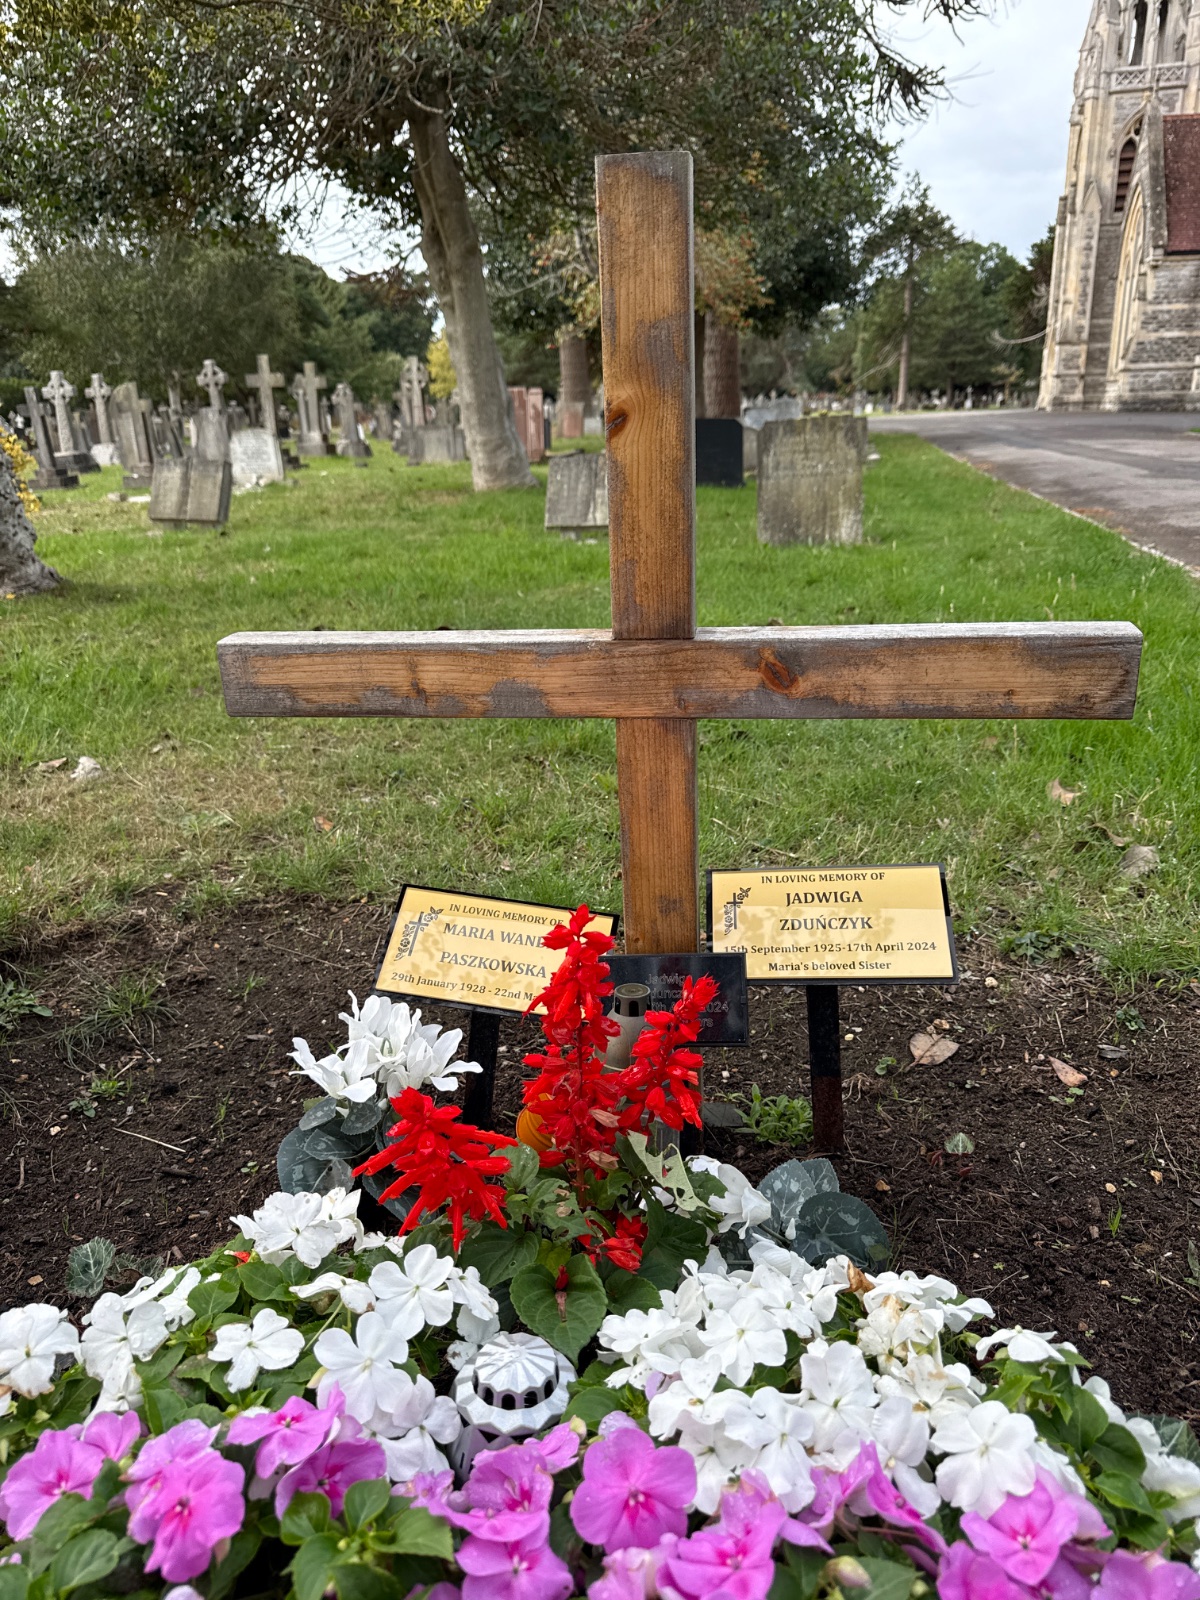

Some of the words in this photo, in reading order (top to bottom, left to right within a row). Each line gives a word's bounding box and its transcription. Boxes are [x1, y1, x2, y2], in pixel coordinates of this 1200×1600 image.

[761, 875, 773, 884] IN
[775, 874, 816, 884] LOVING
[818, 872, 868, 882] MEMORY
[870, 871, 885, 881] OF
[786, 890, 863, 907] JADWIGA
[449, 903, 461, 913] IN
[462, 905, 500, 918] LOVING
[502, 911, 548, 925] MEMORY
[779, 914, 873, 931] ZDUŃCZYK
[442, 922, 495, 942] MARIA
[724, 945, 748, 954] 15th
[750, 944, 810, 956] September
[814, 942, 872, 953] 1925-17th
[875, 941, 904, 954] April
[906, 941, 937, 951] 2024
[439, 951, 547, 978] PASZKOWSKA
[768, 962, 809, 972] Maria's
[811, 960, 856, 971] beloved
[858, 960, 892, 970] Sister
[391, 971, 415, 984] 29th
[416, 976, 457, 991] January
[460, 982, 486, 995] 1928
[494, 987, 521, 999] 22nd
[644, 972, 685, 987] Jadwig
